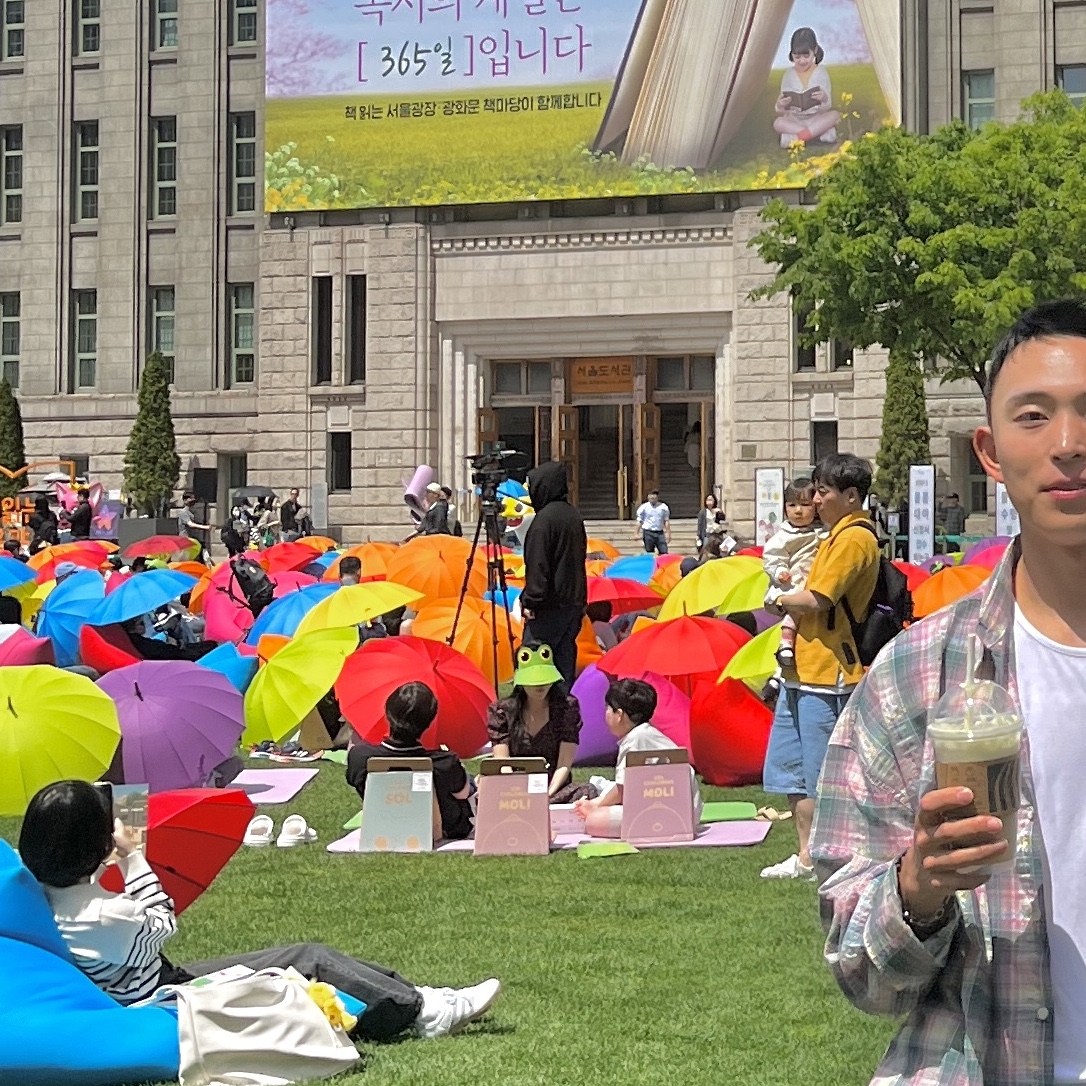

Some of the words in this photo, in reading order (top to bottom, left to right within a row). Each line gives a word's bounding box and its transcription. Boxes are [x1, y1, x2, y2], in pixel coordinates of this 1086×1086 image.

[380, 35, 456, 78] 365일
[344, 105, 356, 120] 책
[359, 104, 383, 120] 읽는
[483, 95, 534, 113] 책마당이
[537, 92, 602, 110] 함께합니다
[577, 364, 631, 377] 서울도서관
[643, 786, 675, 798] MOLI
[498, 798, 531, 810] MOLI
